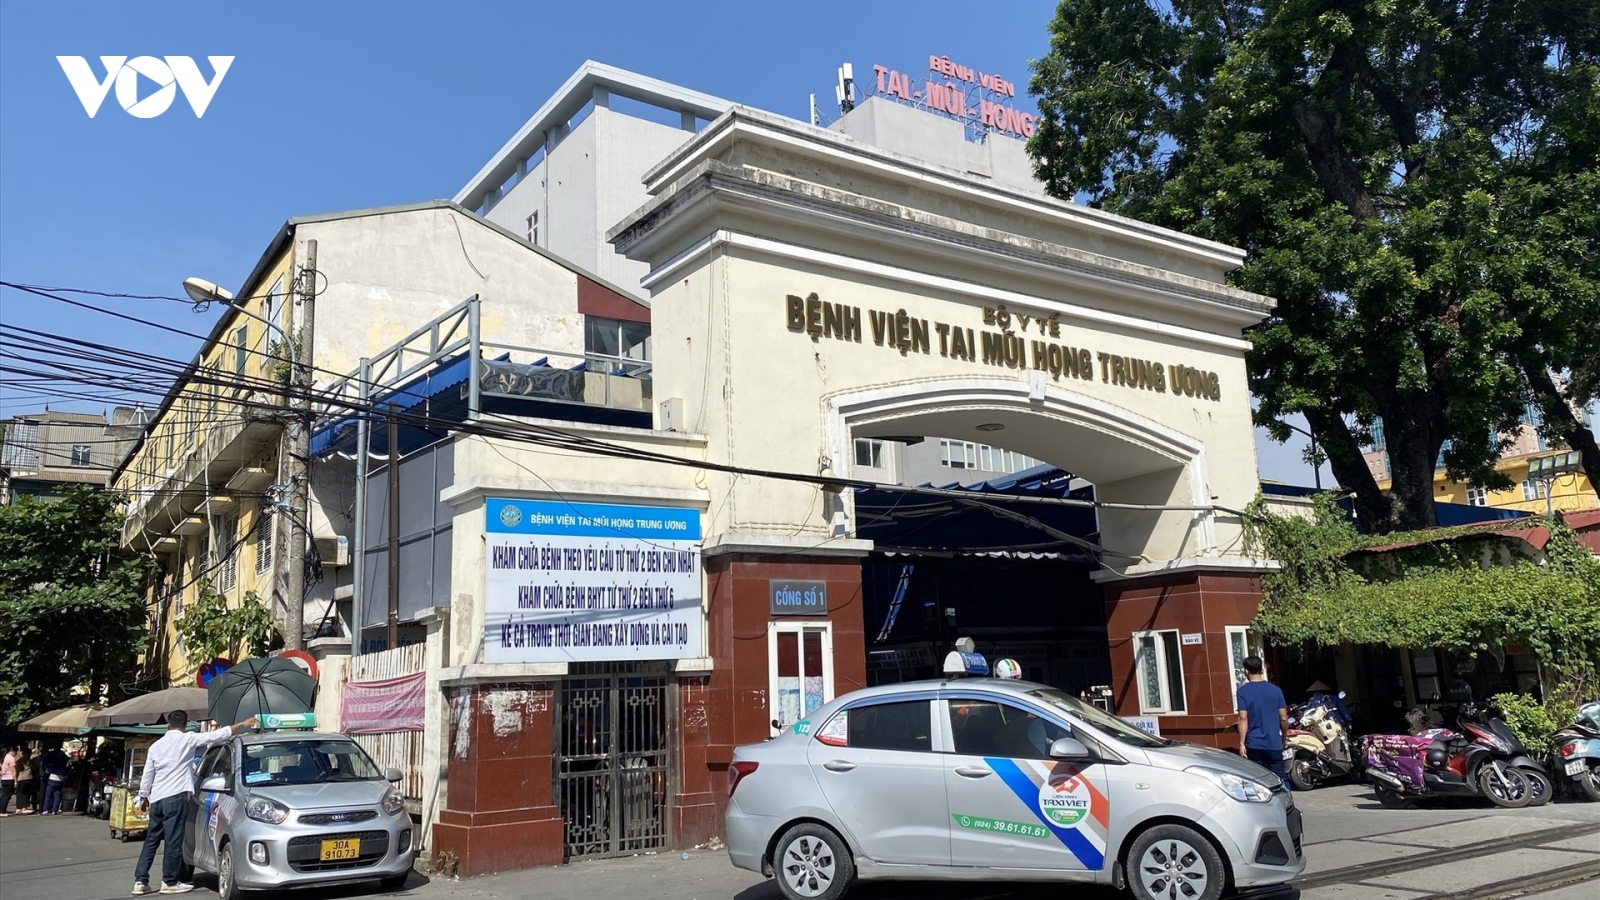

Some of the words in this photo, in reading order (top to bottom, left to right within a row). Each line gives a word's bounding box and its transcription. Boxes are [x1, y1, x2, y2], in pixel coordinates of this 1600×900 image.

[929, 54, 974, 84] BỆNH
[977, 71, 1015, 97] VIỆN
[873, 64, 909, 100] TAI
[926, 81, 966, 117] MŨI
[981, 99, 1034, 138] HỌNG
[982, 304, 1011, 331] BỘ
[1015, 312, 1029, 331] Y
[1035, 312, 1061, 337] TẾ
[785, 292, 862, 342] BỆNH
[868, 308, 930, 356] VIỆN
[934, 321, 976, 362] TAI
[980, 330, 1026, 369] MŨI
[1031, 339, 1093, 381] HỌNG
[1097, 350, 1166, 393] TRUNG
[1168, 363, 1221, 401] ƯƠNG
[530, 511, 554, 527] BỆNH
[556, 513, 576, 528] VIỆN
[577, 516, 591, 526] TAI
[593, 515, 609, 527] MŨI
[611, 518, 634, 531] HỌNG
[635, 519, 663, 529] TRUNG
[664, 519, 687, 531] ƯƠNG
[492, 541, 516, 570] KHÁM
[518, 541, 539, 570] CHỮA
[541, 542, 562, 576] BỆNH
[563, 548, 582, 571] THEO
[583, 544, 598, 572] YÊU
[616, 544, 626, 572] TỪ
[626, 543, 640, 572] THỨ
[641, 550, 646, 572] 2
[647, 543, 661, 573] ĐẾN
[662, 542, 677, 573] CHỦ
[678, 547, 695, 578] NHẬT
[518, 580, 541, 609] KHÁM
[543, 580, 564, 609] CHỮA
[566, 581, 585, 614] BỆNH
[587, 586, 606, 609] BHYT
[607, 581, 617, 609] TỪ
[618, 580, 633, 609] THỨ
[633, 587, 638, 609] 2
[639, 579, 653, 609] ĐẾN
[655, 581, 669, 609] THỨ
[669, 587, 674, 609] 6
[775, 585, 802, 606] CỔNG
[804, 586, 816, 606] SỐ
[818, 591, 824, 606] 1
[501, 614, 513, 648] KỂ
[514, 613, 524, 648] CẢ
[527, 623, 552, 647] TRONG
[554, 617, 571, 647] THỜI
[573, 623, 591, 647] GIAN
[592, 623, 613, 647] ĐANG
[614, 619, 628, 646] XÂY
[630, 621, 649, 651] DỰNG
[651, 618, 660, 645] VÀ
[662, 613, 673, 645] CẢI
[675, 622, 687, 650] TẠO
[798, 724, 811, 733] 123
[974, 820, 991, 829] (024)
[993, 820, 1046, 837] 39.61.61.61
[325, 849, 356, 859] 910.73
[333, 841, 349, 850] 30A
